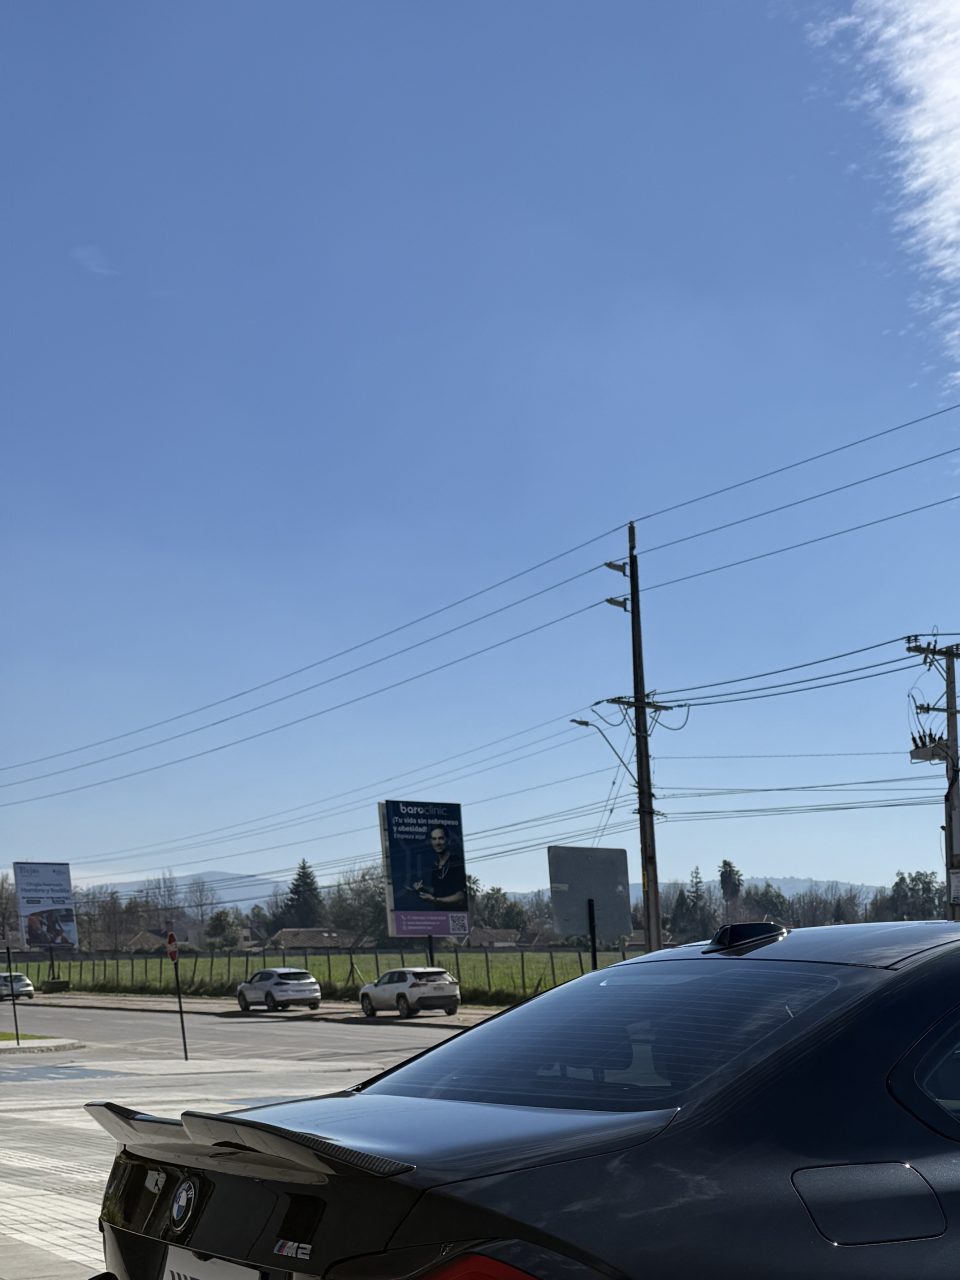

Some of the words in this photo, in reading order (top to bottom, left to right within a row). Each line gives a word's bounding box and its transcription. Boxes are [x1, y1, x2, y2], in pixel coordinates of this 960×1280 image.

[399, 803, 448, 815] baroclinic
[417, 817, 427, 825] sin
[281, 1241, 313, 1260] M2
